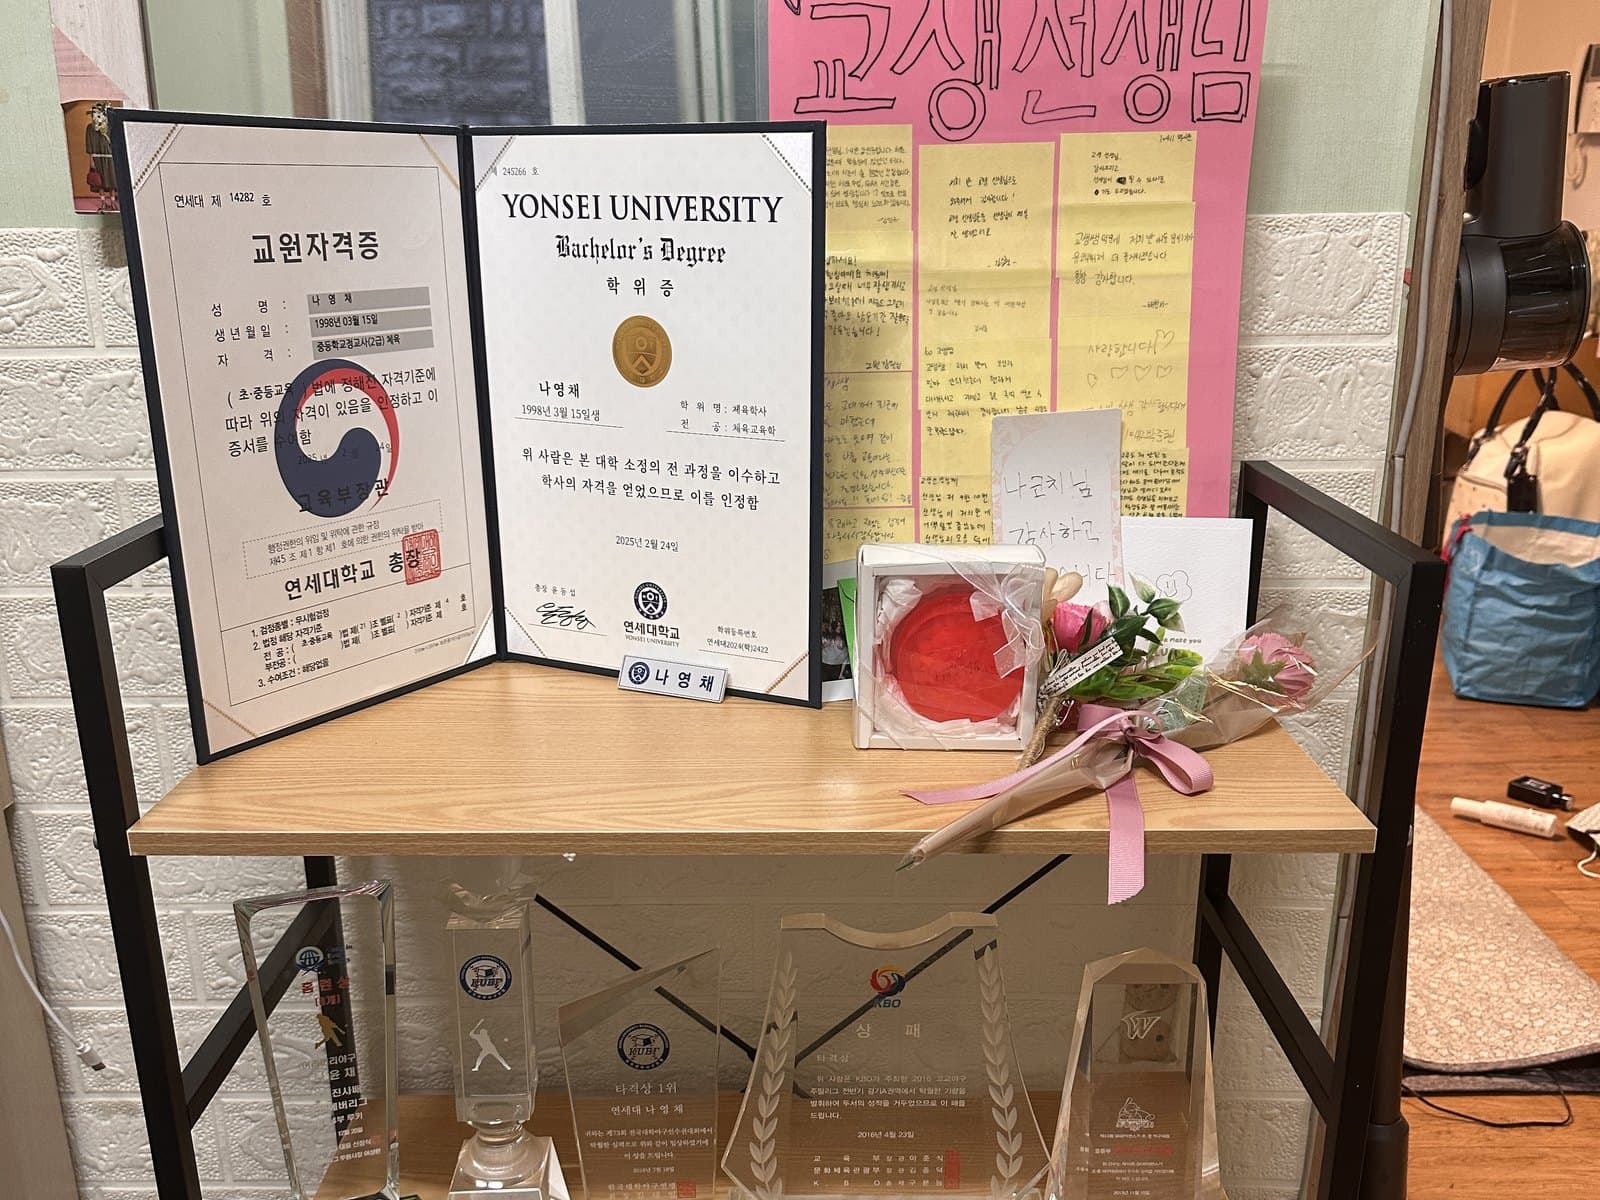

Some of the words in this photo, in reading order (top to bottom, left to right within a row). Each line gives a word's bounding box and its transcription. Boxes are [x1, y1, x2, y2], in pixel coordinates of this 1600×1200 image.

[502, 166, 528, 176] 245266
[531, 166, 540, 176] 호
[174, 194, 204, 208] 연세대
[212, 194, 222, 208] 제
[229, 192, 255, 203] 14282
[262, 194, 272, 207] 호
[502, 193, 602, 219] YONSEI
[609, 194, 784, 223] UNIVERSITY
[251, 230, 379, 264] 교원자격증
[555, 234, 653, 264] Bachelor's
[660, 237, 727, 267] Degree
[211, 303, 223, 318] 성
[258, 300, 269, 314] 명
[314, 316, 342, 329] 1998년
[343, 314, 361, 328] 03월
[362, 313, 378, 326] 15일
[311, 377, 337, 397] 법에
[341, 374, 378, 393] 정해진
[382, 366, 437, 387] 자격기준에
[225, 416, 253, 433] 따라
[293, 403, 330, 423] 자격이
[335, 397, 372, 417] 있음을
[377, 391, 422, 411] 인정하고
[428, 388, 439, 403] 이
[521, 404, 551, 418] 1998년
[553, 406, 568, 420] 3월
[570, 408, 600, 422] 15일생
[228, 437, 269, 458] 증서를
[523, 447, 532, 462] 위
[538, 449, 573, 466] 사람은
[579, 452, 590, 468] 본
[596, 454, 619, 470] 대학
[624, 459, 661, 475] 소정의
[667, 461, 678, 476] 전
[684, 463, 722, 481] 과정을
[728, 466, 780, 485] 이수하고
[541, 473, 576, 491] 학사의
[582, 479, 617, 496] 자격을
[623, 483, 685, 502] 얻었으므로
[690, 489, 715, 507] 이를
[721, 493, 759, 511] 인정함
[268, 536, 304, 554] 행정권한의
[305, 533, 319, 544] 위임
[352, 523, 365, 534] 관한
[366, 520, 380, 531] 규정
[1009, 517, 1100, 546] 감사하고
[615, 535, 643, 548] 2025년
[645, 538, 658, 550] 2월
[660, 540, 678, 552] 24일
[284, 560, 376, 601] 연세대학교
[251, 629, 259, 638] 1.
[253, 642, 260, 651] 2.
[295, 623, 323, 638] 자격기준
[623, 620, 680, 641] 연세대학교
[625, 634, 646, 645] YONSEI
[647, 637, 680, 648] UNIVERSITY
[258, 678, 266, 688] 3.
[874, 999, 902, 1008] KBO
[616, 1082, 651, 1095] 타격상
[659, 1081, 678, 1095] 1위
[810, 1112, 842, 1121] 드립니다.
[857, 1131, 883, 1139] 2016년
[884, 1131, 896, 1139] 4월
